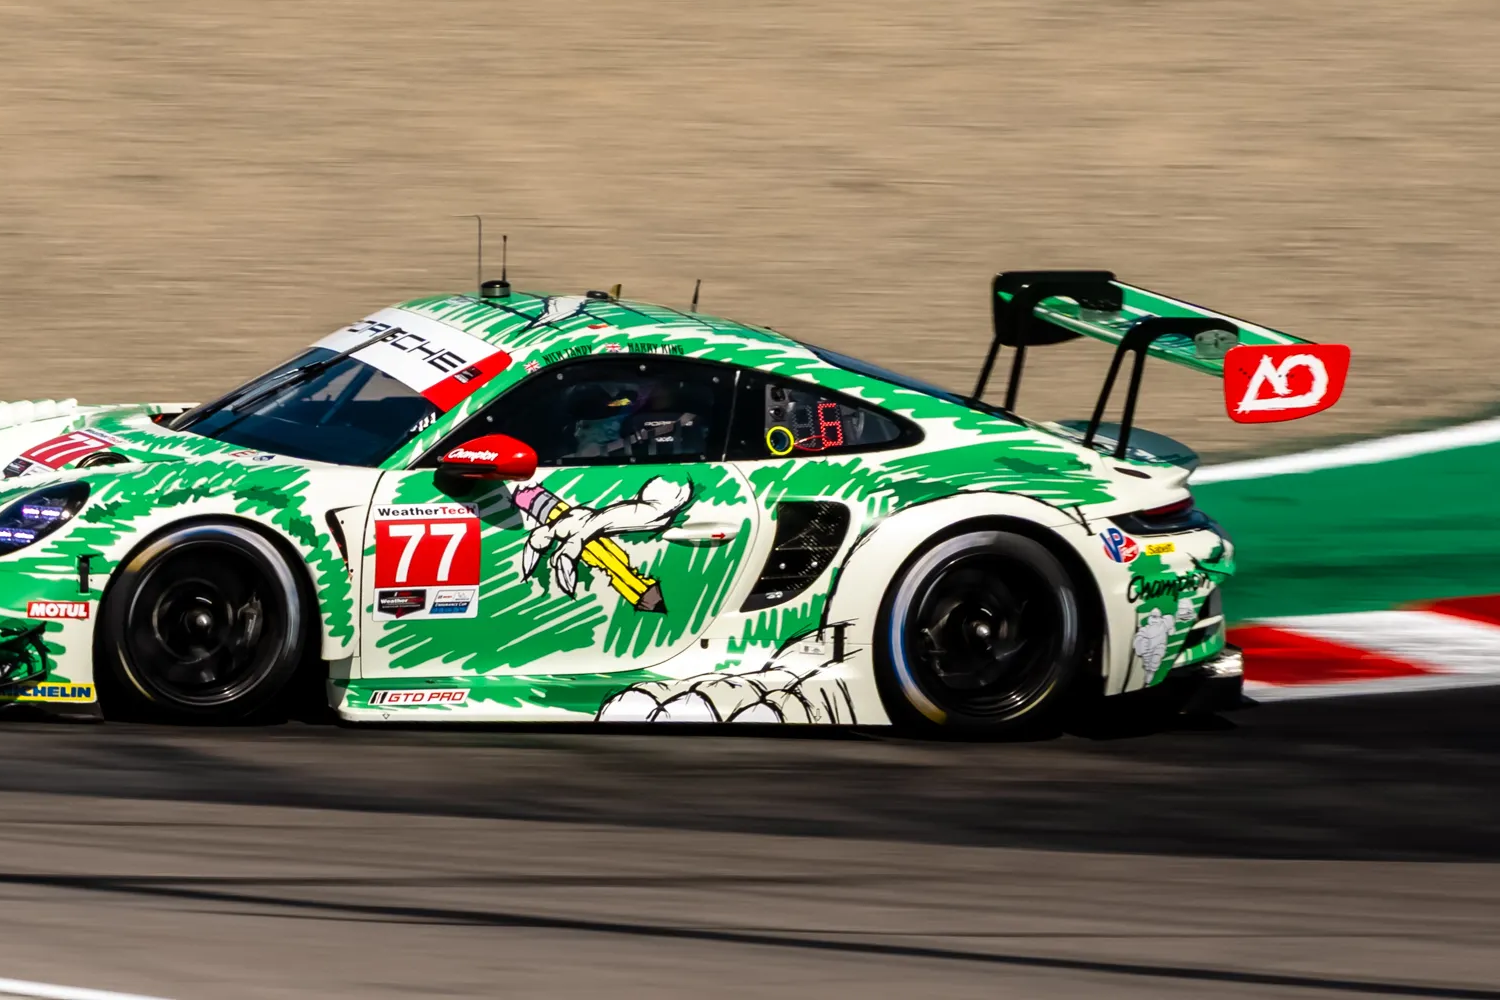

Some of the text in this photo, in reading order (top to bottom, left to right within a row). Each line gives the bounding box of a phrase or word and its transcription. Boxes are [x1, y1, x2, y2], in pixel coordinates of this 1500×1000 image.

[347, 320, 467, 373] ORSCHE
[660, 344, 684, 356] KING
[818, 402, 844, 447] 6
[30, 433, 106, 463] 77
[448, 448, 498, 462] Champion
[378, 506, 476, 516] WeatherTech
[388, 523, 467, 583] 77
[1100, 528, 1125, 563] VP
[1127, 573, 1211, 603] Champion
[30, 603, 87, 617] MOTUL
[388, 691, 465, 702] GTD PRO
